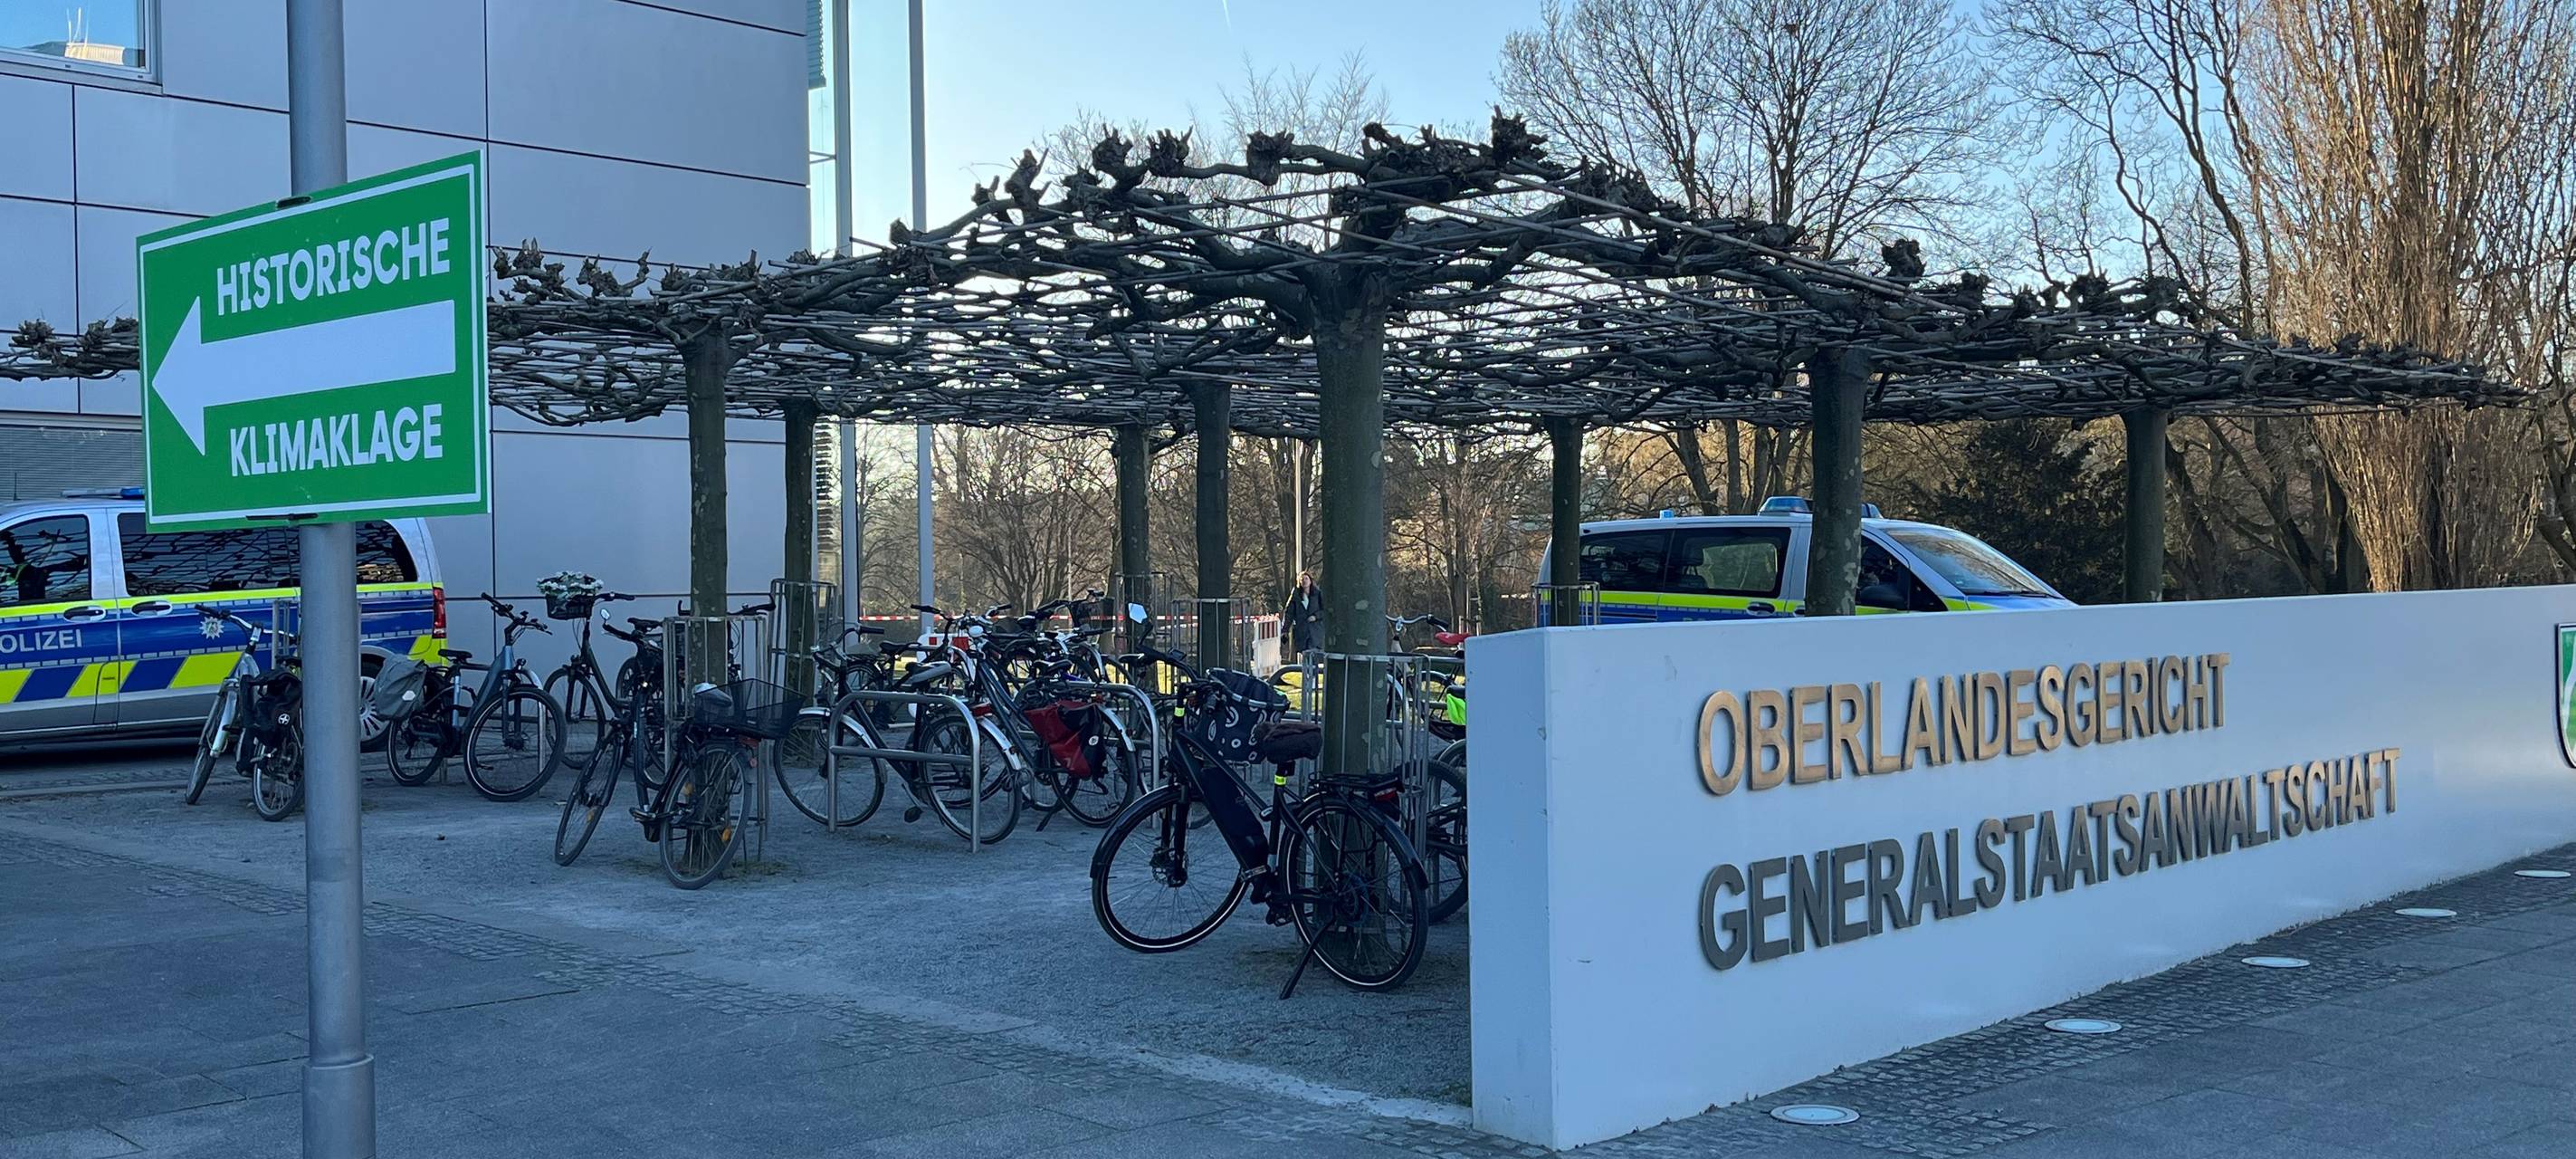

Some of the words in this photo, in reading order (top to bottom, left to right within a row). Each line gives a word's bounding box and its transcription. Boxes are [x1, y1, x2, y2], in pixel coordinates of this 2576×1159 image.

[216, 217, 450, 316] HISTORISCHE
[230, 404, 444, 476] KLIMAKLAGE
[1697, 653, 2230, 796] OBERLANDESGERICHT
[1700, 748, 2400, 972] GENERALSTAATSANWALTSCHAFT
